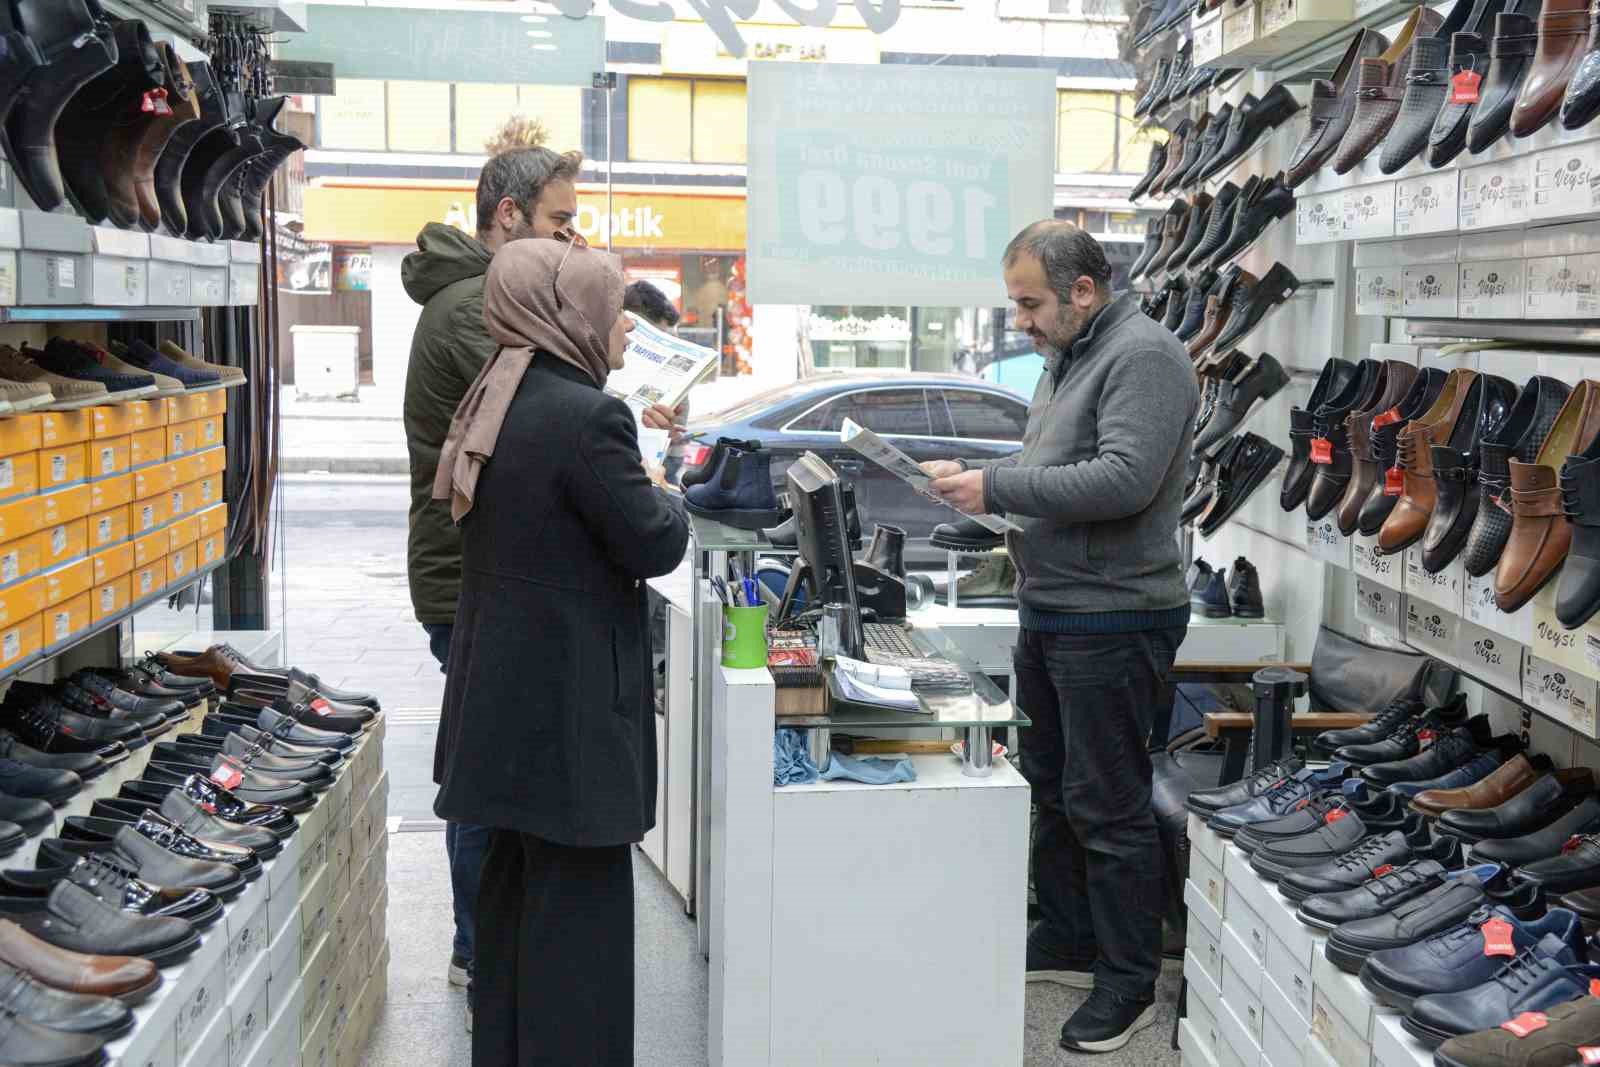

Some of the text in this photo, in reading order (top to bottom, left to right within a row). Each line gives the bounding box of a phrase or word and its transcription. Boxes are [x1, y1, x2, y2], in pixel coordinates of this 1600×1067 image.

[572, 206, 664, 242] Optik
[1538, 621, 1575, 648] Veysi
[1474, 641, 1501, 665] Veysi
